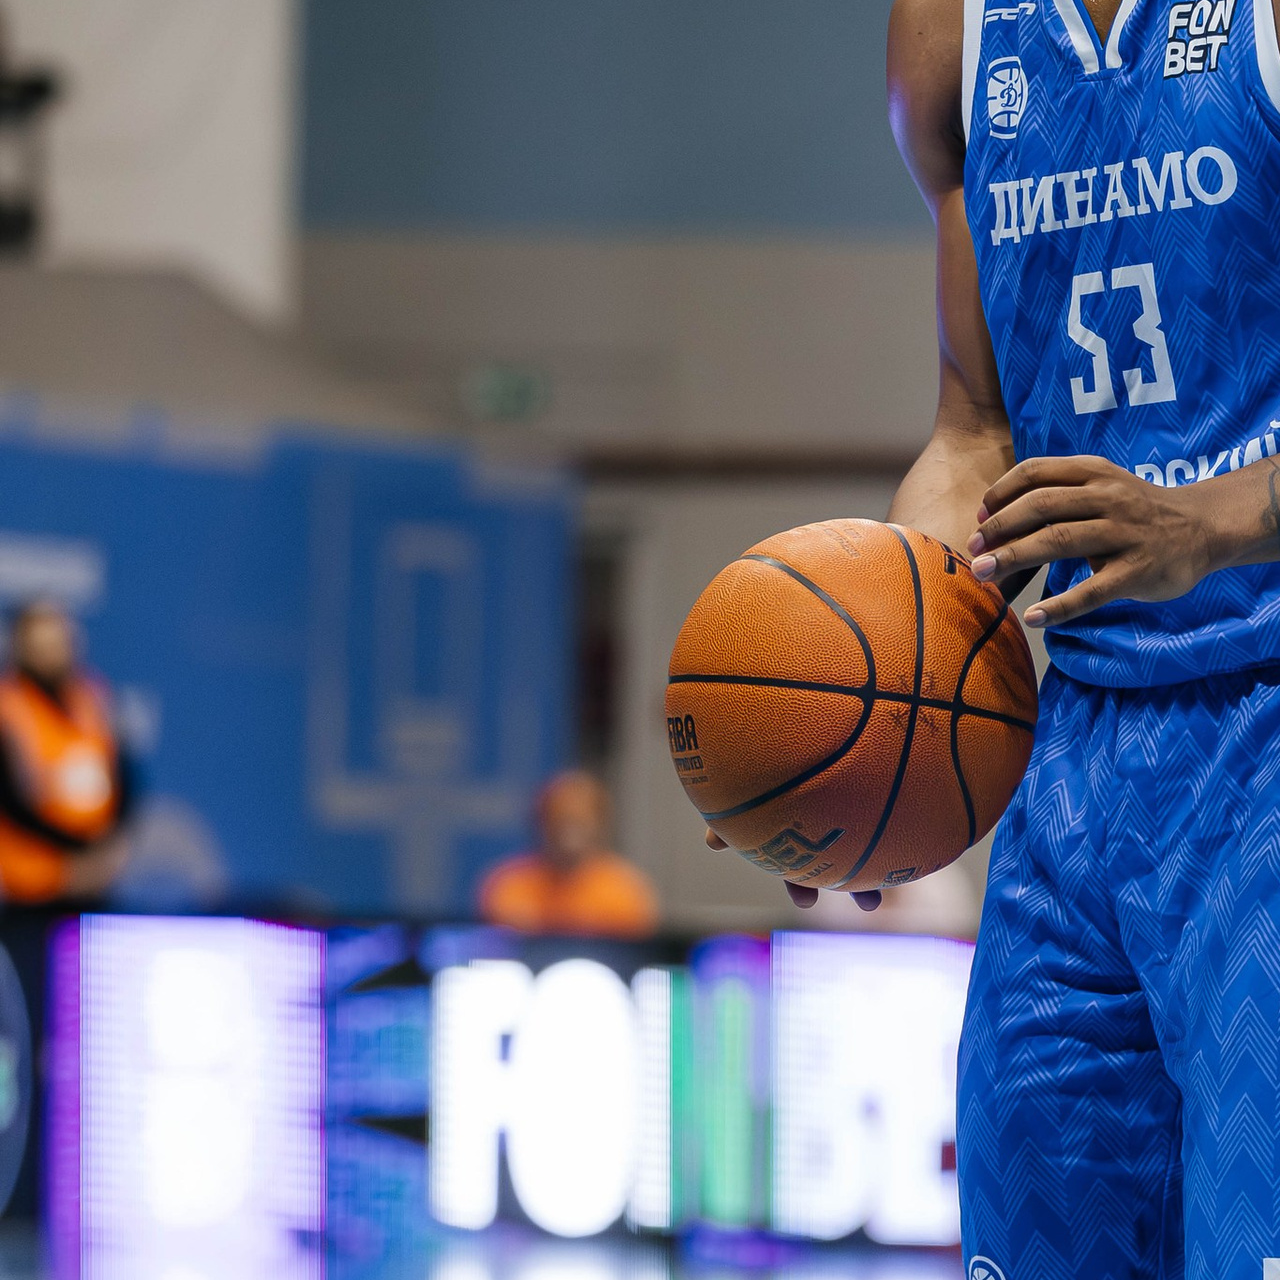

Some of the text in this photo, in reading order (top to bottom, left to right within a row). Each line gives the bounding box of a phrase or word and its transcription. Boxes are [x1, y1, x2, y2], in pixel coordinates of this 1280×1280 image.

[1163, 34, 1229, 78] BET
[988, 145, 1239, 247] ДИНАМО
[1067, 262, 1177, 415] 53
